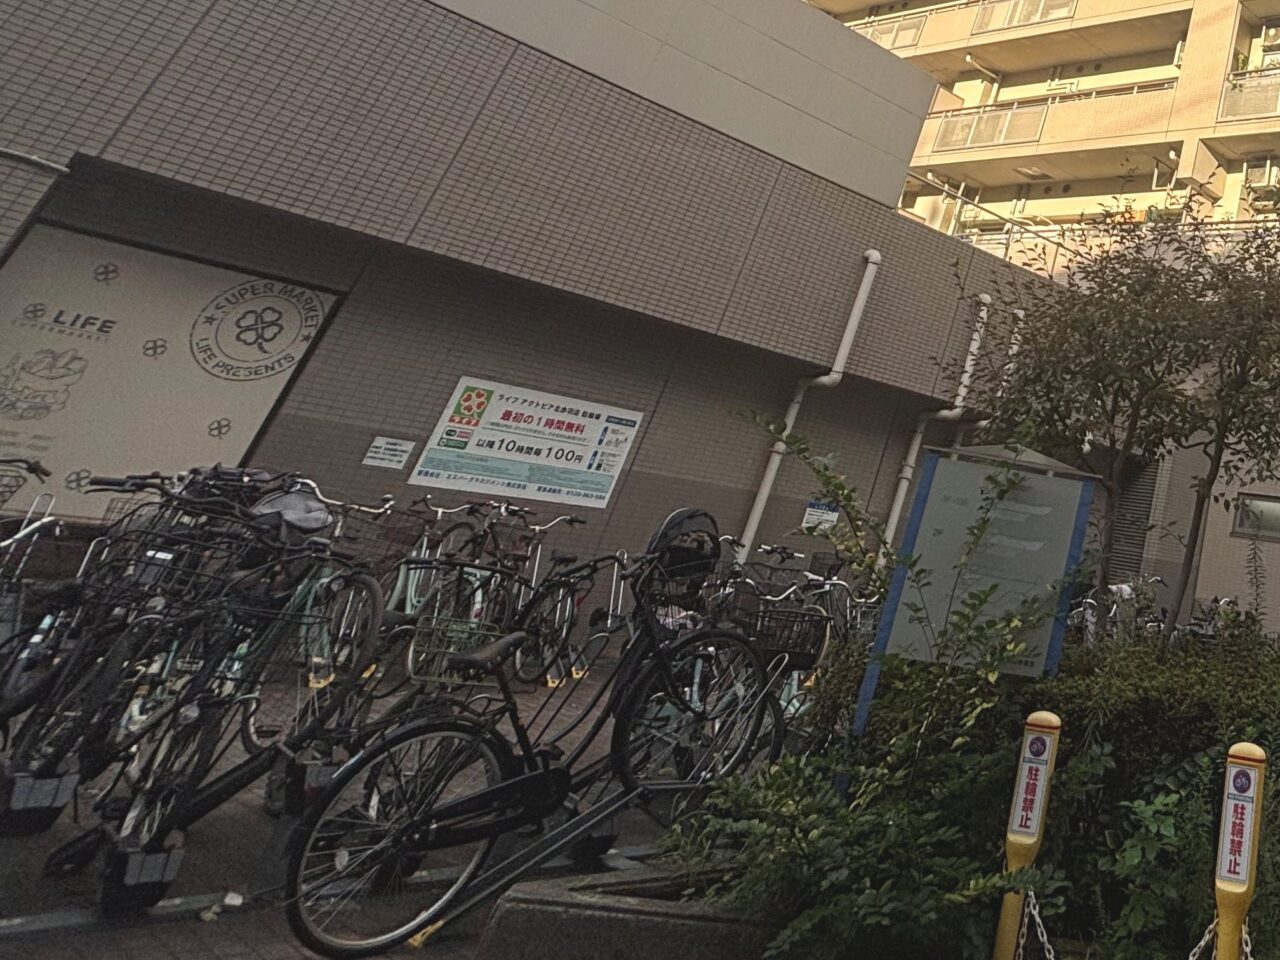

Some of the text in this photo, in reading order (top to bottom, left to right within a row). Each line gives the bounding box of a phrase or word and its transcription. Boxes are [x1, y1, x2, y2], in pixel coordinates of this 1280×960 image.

[53, 309, 117, 334] LIFE
[215, 282, 320, 330] SUPER MARKET
[196, 337, 295, 378] LIFE PRESENTS
[1018, 765, 1040, 829] 駐輪禁止
[1227, 803, 1247, 876] 駐輪禁止
